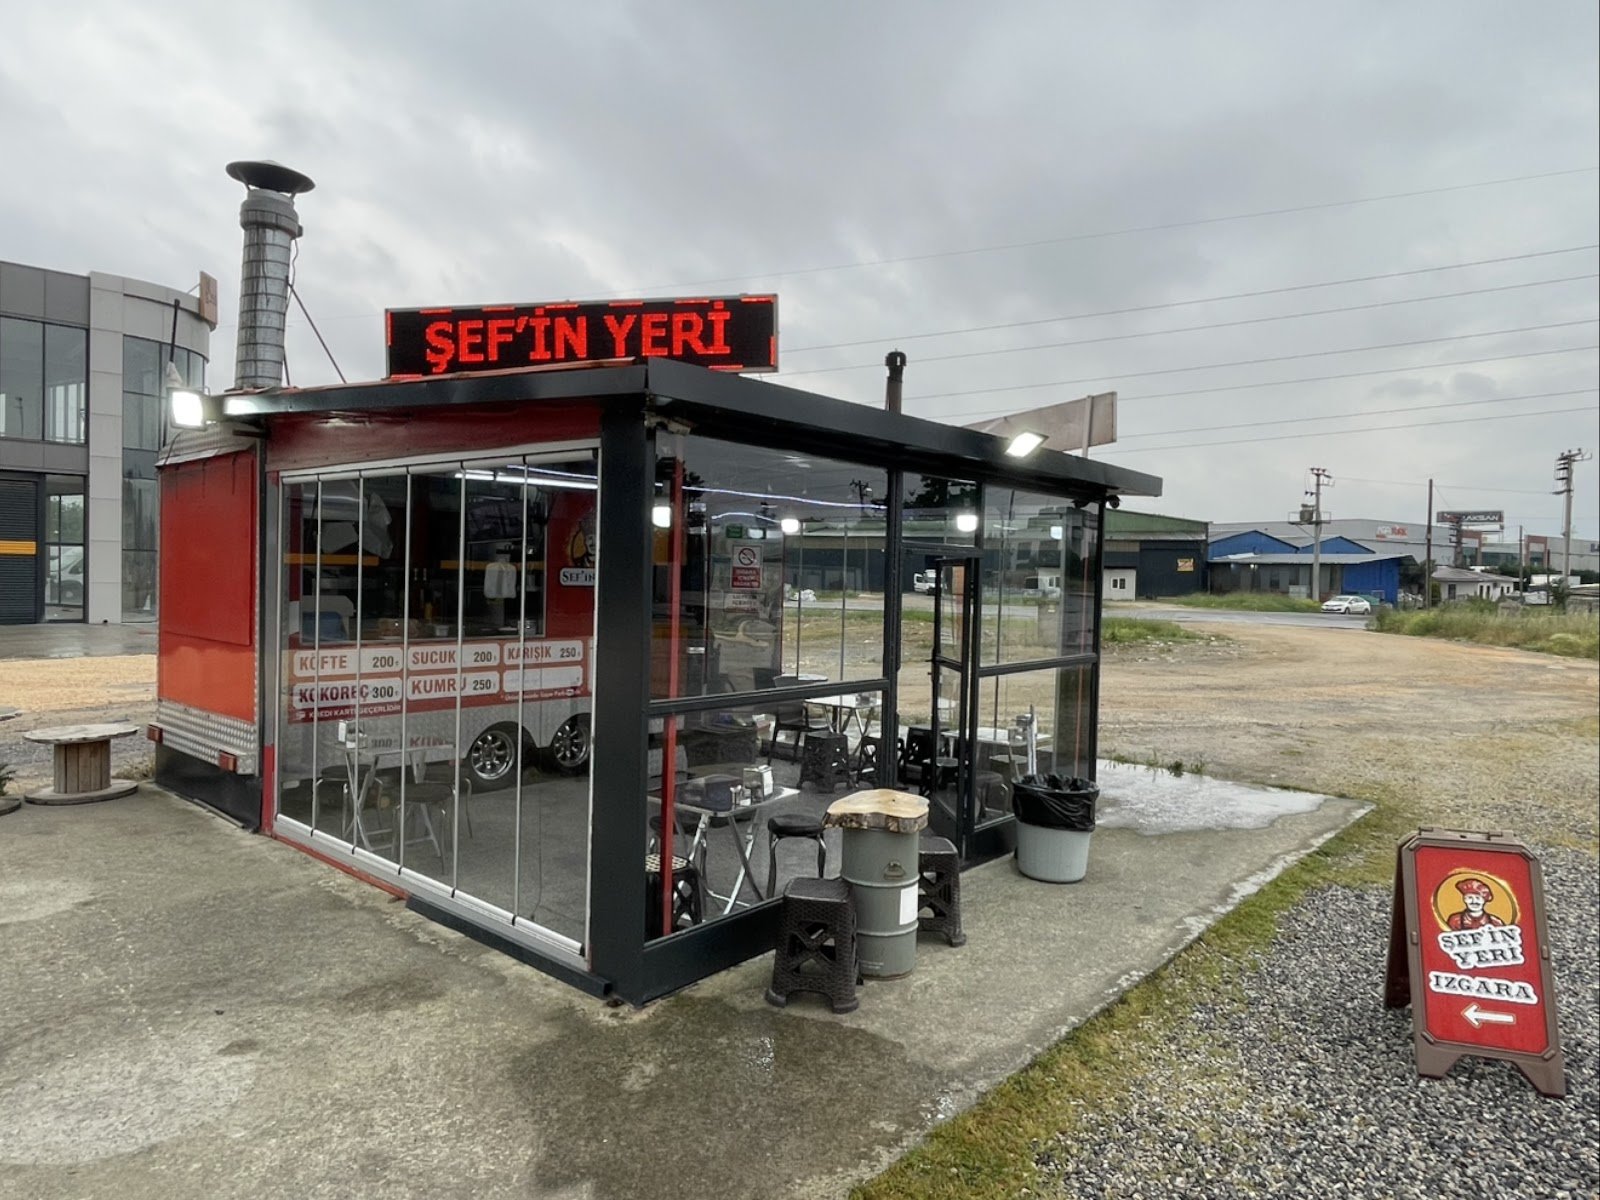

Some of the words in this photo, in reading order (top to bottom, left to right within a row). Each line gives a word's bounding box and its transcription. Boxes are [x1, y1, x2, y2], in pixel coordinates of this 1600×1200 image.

[425, 308, 587, 373] ŞEF'İN
[604, 301, 731, 357] YERİ
[412, 650, 457, 665] SUCUK
[1441, 926, 1519, 951] ŞEF'İN
[1454, 943, 1521, 966] YERİ
[1432, 974, 1534, 1001] IZGARA
